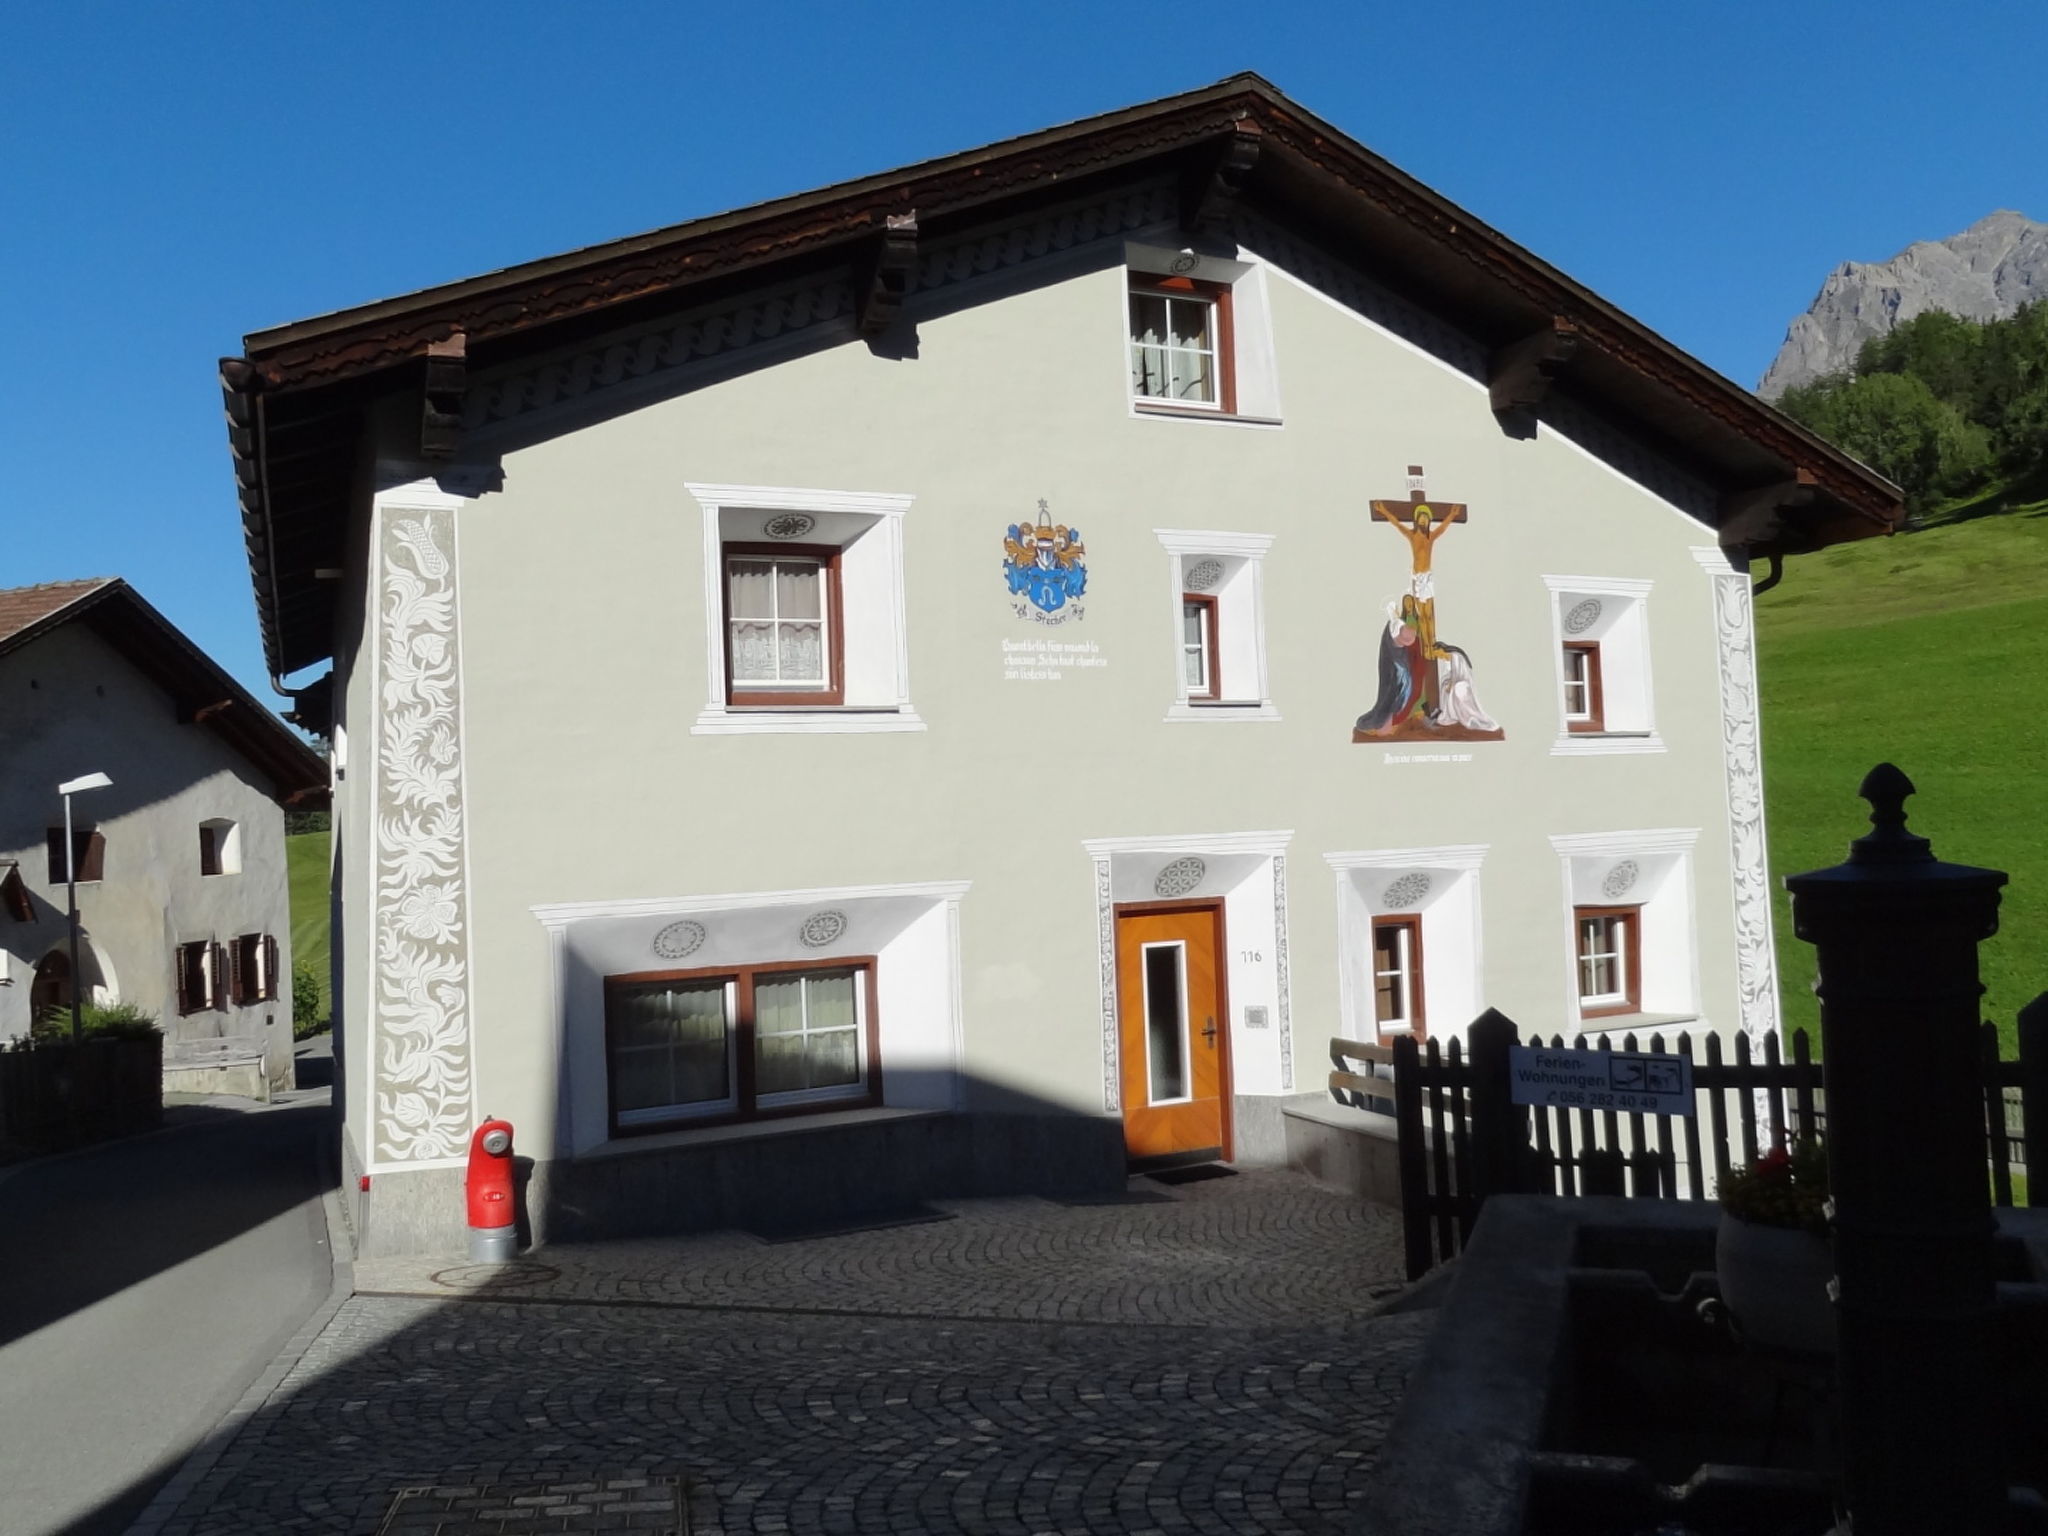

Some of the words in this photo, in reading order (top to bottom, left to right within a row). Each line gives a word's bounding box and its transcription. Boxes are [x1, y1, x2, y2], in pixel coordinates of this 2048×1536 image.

[1241, 950, 1262, 963] 116
[1536, 1054, 1586, 1070] Ferien-
[1518, 1069, 1606, 1089] Wohnungen
[1559, 1090, 1585, 1104] 056
